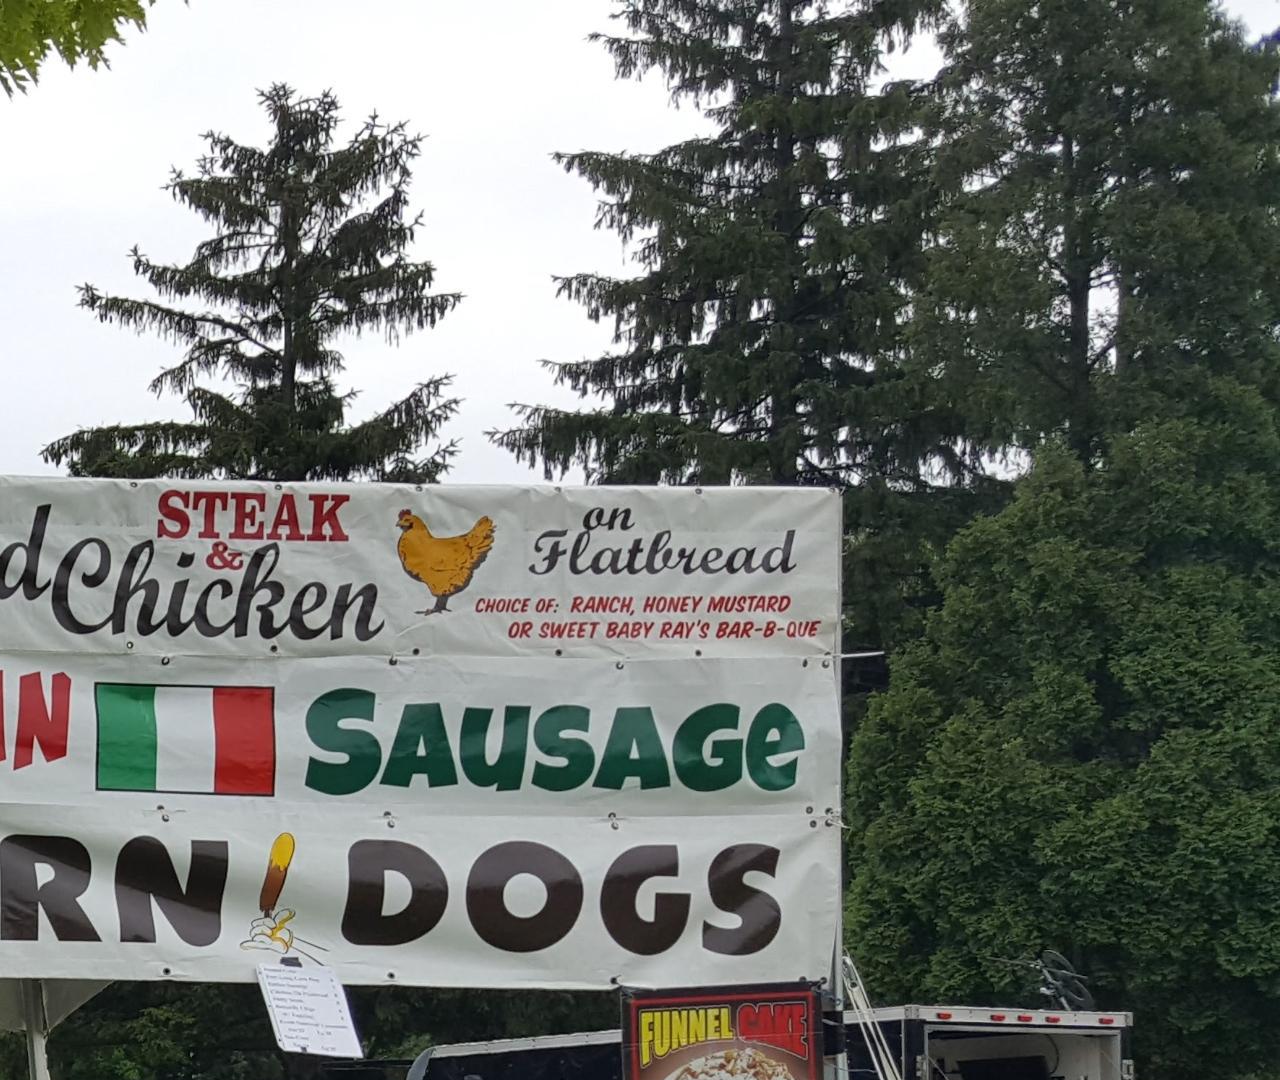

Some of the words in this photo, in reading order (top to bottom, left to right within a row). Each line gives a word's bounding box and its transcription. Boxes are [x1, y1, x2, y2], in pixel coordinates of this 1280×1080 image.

[157, 489, 351, 542] STEAK
[582, 505, 636, 532] on
[205, 541, 244, 571] &
[528, 528, 798, 576] Flatbread
[52, 538, 385, 642] Chicken
[475, 598, 530, 614] CHOICE
[535, 598, 560, 614] OF:
[570, 595, 636, 616] RANCH,
[642, 595, 702, 613] HONEY
[707, 595, 791, 613] MUSTARD
[508, 621, 535, 639] OR
[538, 622, 600, 639] SWEET
[606, 621, 655, 639] BABY
[659, 621, 710, 639] RAY'S
[715, 620, 822, 639] BAR-B-QUE
[340, 841, 782, 956] DOGS
[640, 1005, 734, 1068] FUNNEL
[737, 1002, 808, 1060] CAKE
